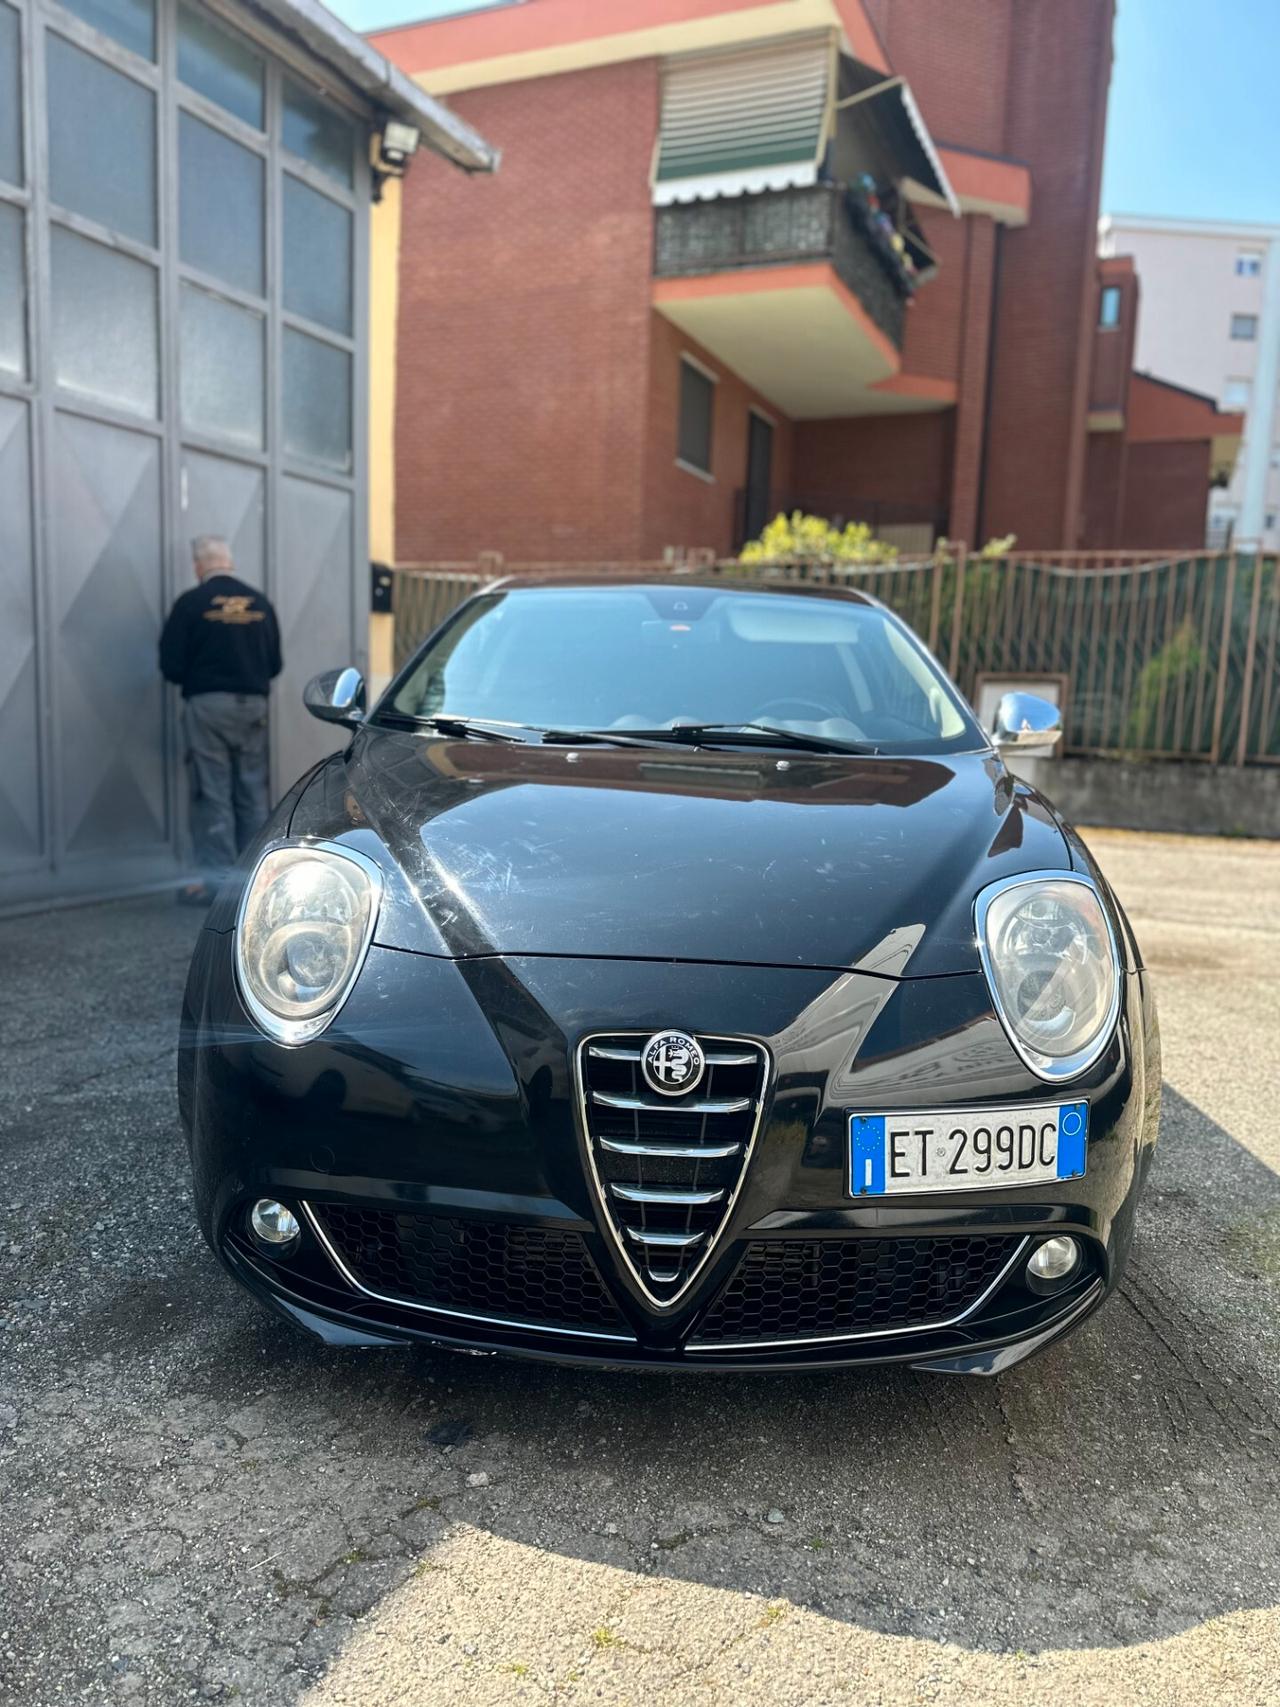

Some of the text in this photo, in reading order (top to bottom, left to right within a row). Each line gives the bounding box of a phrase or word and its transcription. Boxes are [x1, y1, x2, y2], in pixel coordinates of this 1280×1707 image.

[647, 1036, 700, 1065] ALFA ROMEO
[890, 1122, 1057, 1178] ET 299DC
[865, 1158, 873, 1186] I
